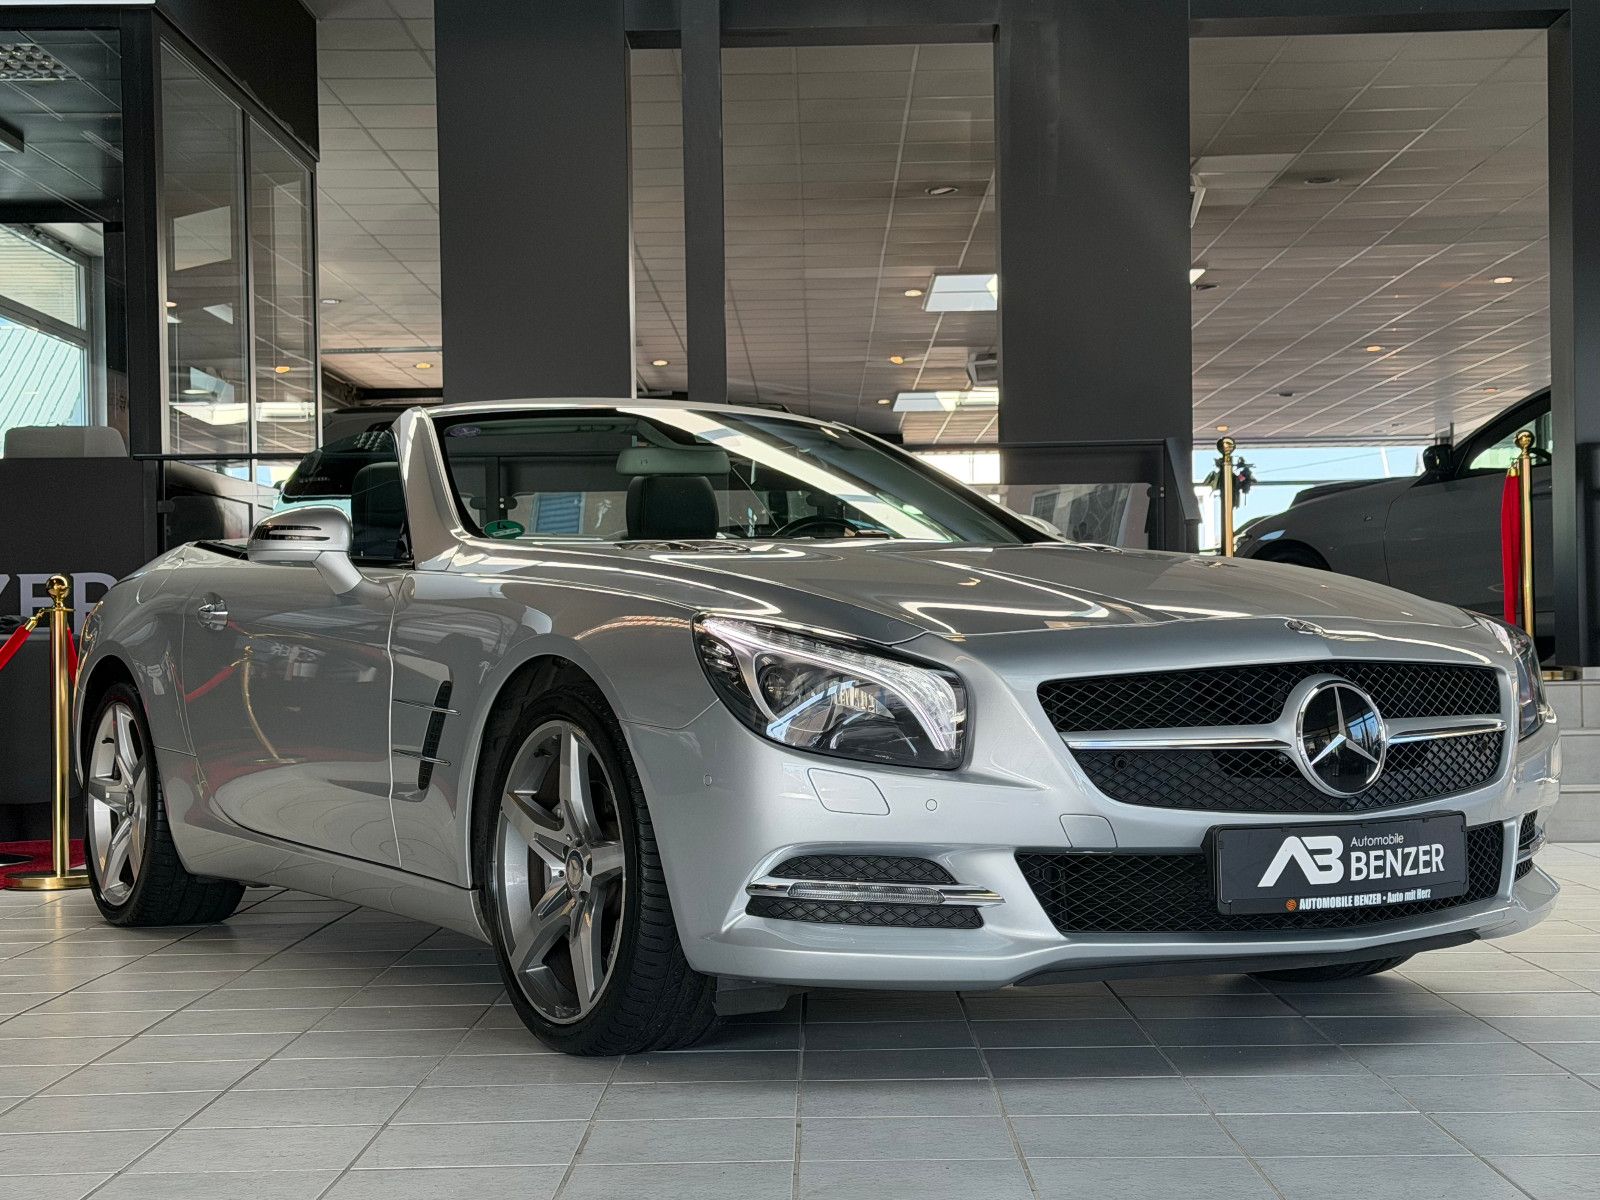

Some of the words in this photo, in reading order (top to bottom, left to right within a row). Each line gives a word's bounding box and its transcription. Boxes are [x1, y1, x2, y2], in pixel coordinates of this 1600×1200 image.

[1350, 832, 1404, 848] Automobile
[1349, 843, 1445, 881] BENZER
[1299, 895, 1353, 910] AUTOMOBILE
[1353, 892, 1382, 907] BENZER
[1387, 891, 1404, 904] Auto
[1404, 889, 1416, 902] mit
[1416, 888, 1431, 900] Herz
